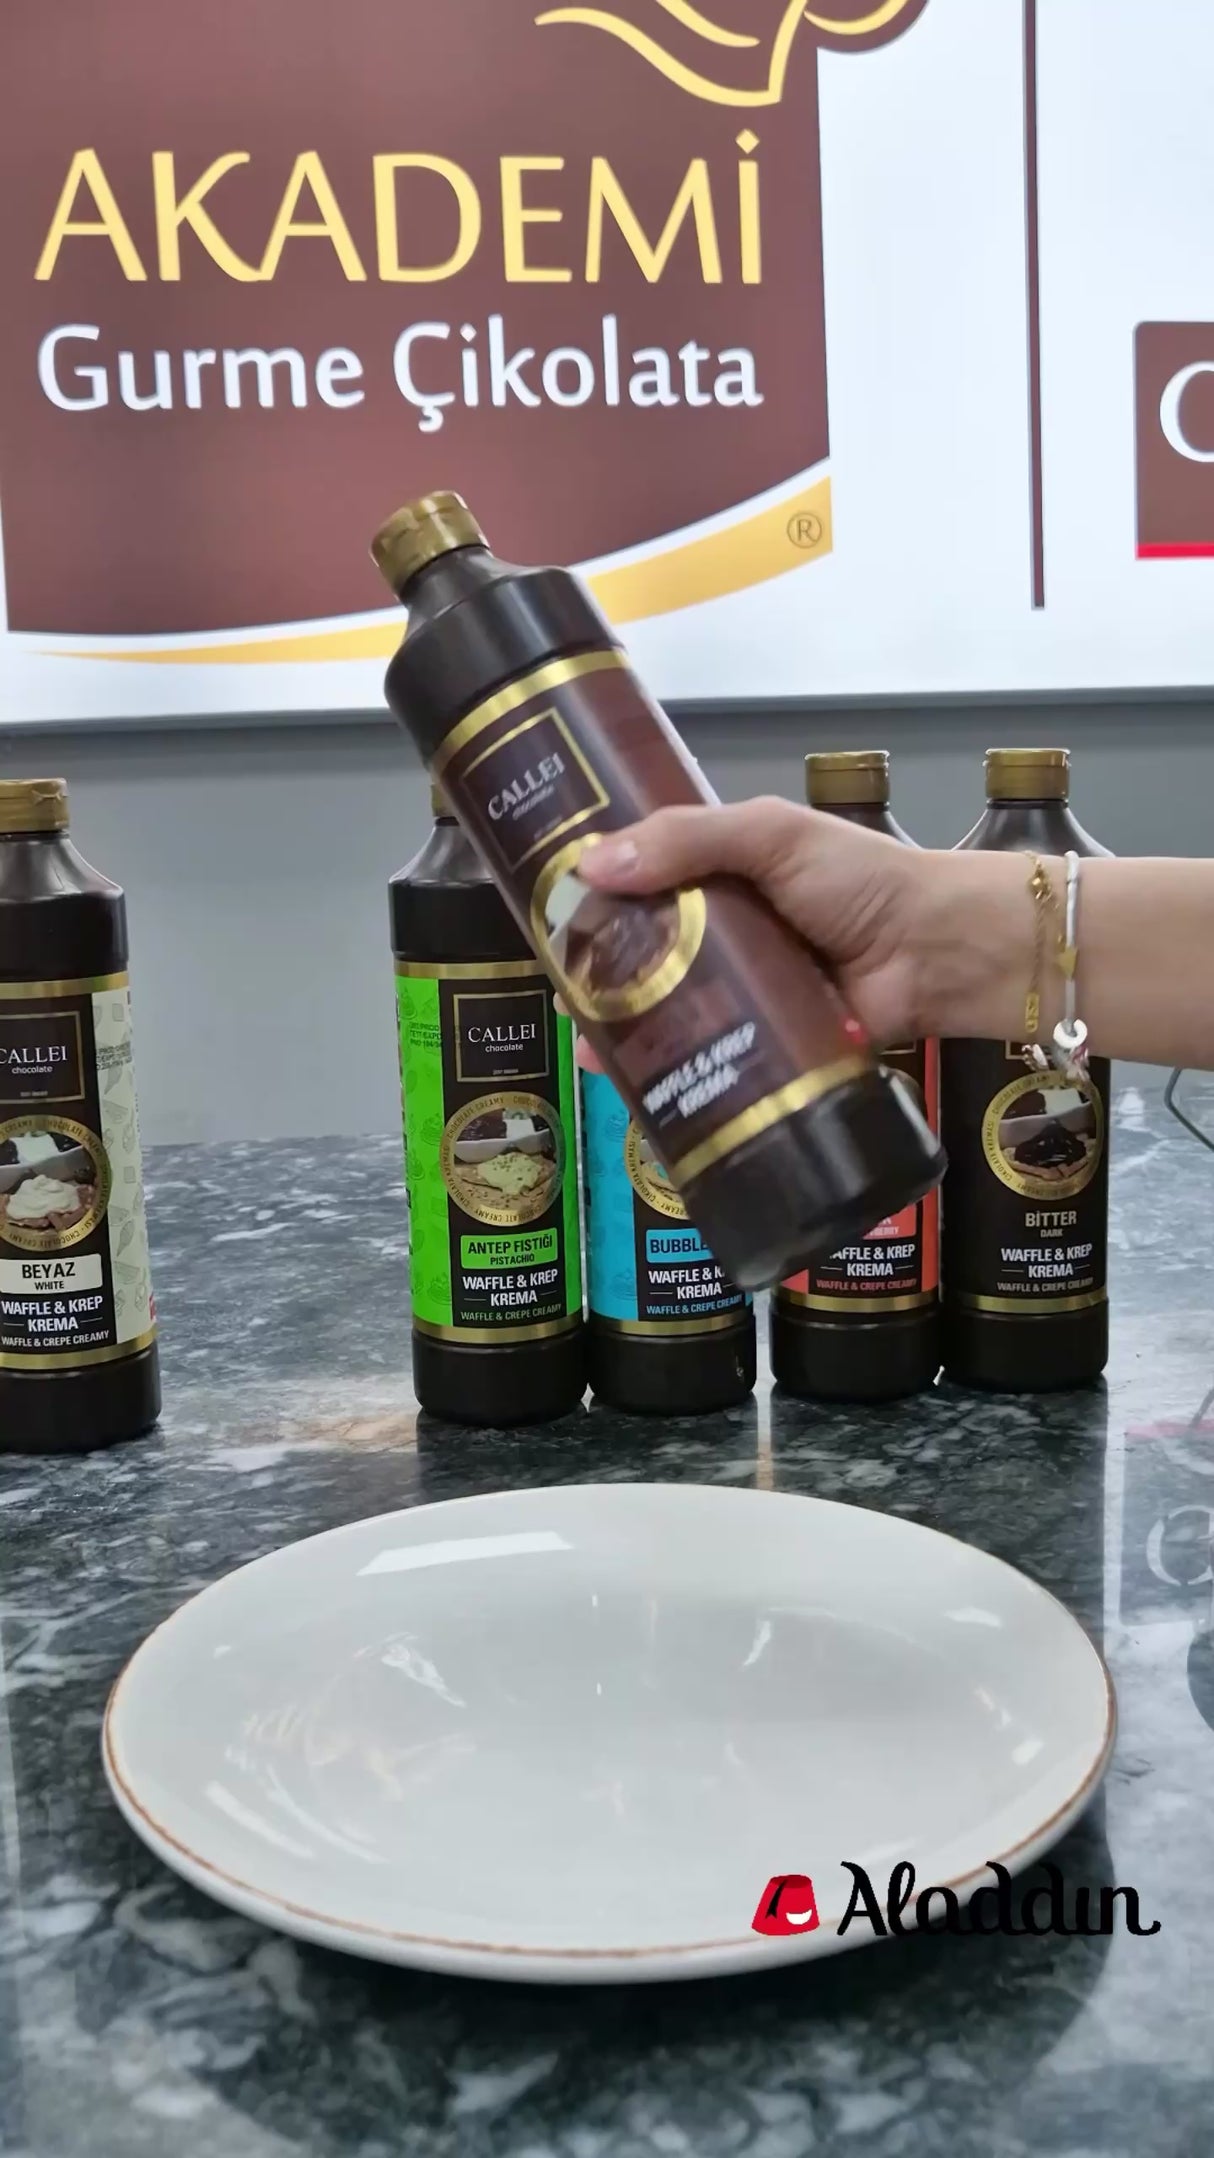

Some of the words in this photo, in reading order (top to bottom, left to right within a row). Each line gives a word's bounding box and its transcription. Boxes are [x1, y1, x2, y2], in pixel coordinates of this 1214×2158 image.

[34, 128, 763, 285] AKADEMİ
[38, 323, 366, 413] Gurme
[393, 313, 764, 433] Çikolata
[488, 752, 565, 820] CALLEI
[467, 1023, 537, 1043] CALLEI
[485, 1043, 524, 1053] chocolate
[11, 1065, 53, 1074] chocolate
[1040, 1228, 1063, 1238] DARK
[468, 1241, 511, 1254] ANTEP
[873, 1246, 885, 1260] &
[886, 1243, 915, 1259] KREP
[1000, 1248, 1053, 1261] WAFFLE
[1054, 1248, 1065, 1260] &
[1066, 1243, 1092, 1260] KREP
[490, 1253, 535, 1265] PISTACHIO
[22, 1262, 76, 1279] BEYAZ
[648, 1268, 700, 1284] WAFFLE
[702, 1267, 712, 1280] &
[847, 1263, 894, 1277] KREMA
[1028, 1263, 1074, 1278] KREMA
[34, 1280, 65, 1291] WHITE
[462, 1275, 514, 1290] WAFFLE
[516, 1274, 527, 1288] &
[530, 1268, 558, 1287] KREP
[997, 1282, 1031, 1292] WAFFLE
[490, 1290, 538, 1307] KREMA
[677, 1282, 722, 1300] KREMA
[1, 1300, 52, 1316] WAFFLE
[54, 1301, 66, 1314] &
[68, 1295, 103, 1313] KREP
[461, 1311, 494, 1321] WAFFLE
[495, 1311, 503, 1320] &
[505, 1308, 530, 1320] CREPE
[532, 1303, 562, 1317] CREAMY
[646, 1304, 680, 1315] WAFFLE
[681, 1304, 689, 1314] &
[691, 1301, 716, 1313] CREPE
[28, 1317, 79, 1332] KREMA
[1, 1335, 32, 1347] WAFFLE
[33, 1338, 41, 1347] &
[43, 1336, 71, 1347] CREPE
[73, 1330, 110, 1345] CREAMY
